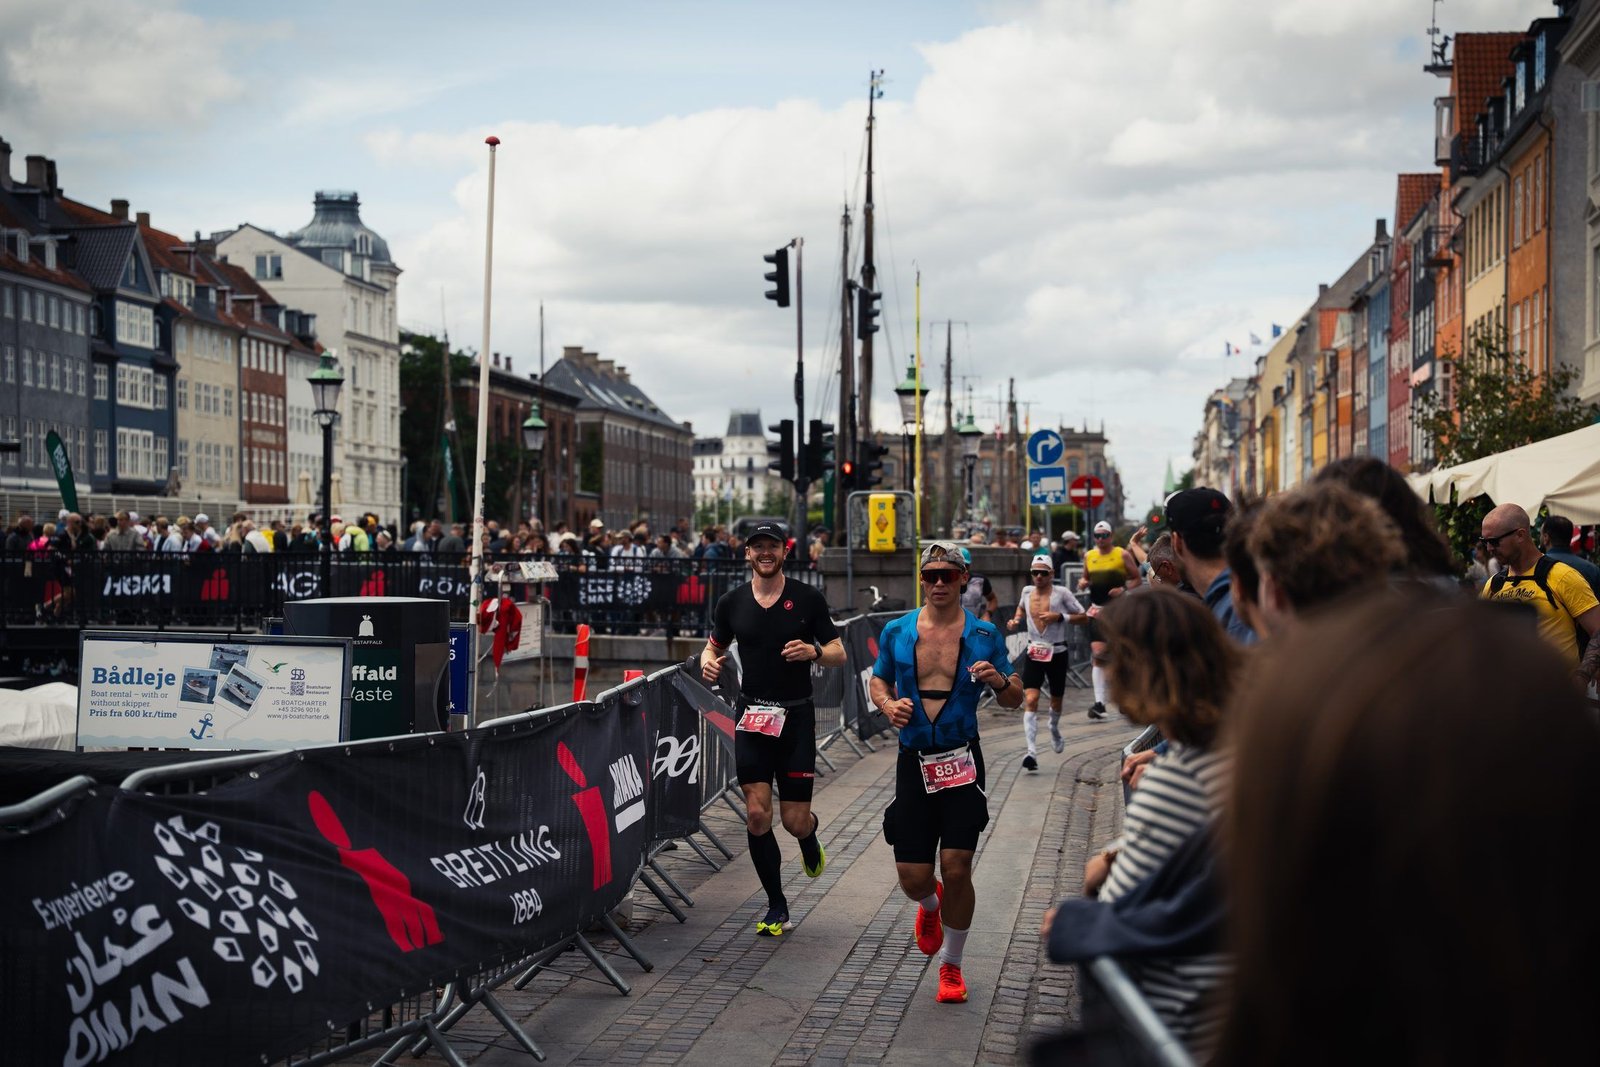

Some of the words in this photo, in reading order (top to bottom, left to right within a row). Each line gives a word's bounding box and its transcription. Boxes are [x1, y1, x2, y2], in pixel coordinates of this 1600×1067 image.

[92, 665, 176, 690] Bådleje
[351, 665, 397, 681] ffald
[109, 690, 132, 698] rental
[141, 691, 159, 699] with
[89, 708, 108, 717] Pris
[110, 708, 122, 717] fra
[124, 709, 140, 718] 600
[142, 710, 177, 719] kr./time
[935, 761, 960, 777] 881
[430, 825, 561, 888] BREITLING
[32, 870, 135, 931] Experience
[510, 888, 543, 925] 1884
[63, 956, 211, 1067] OMAN
